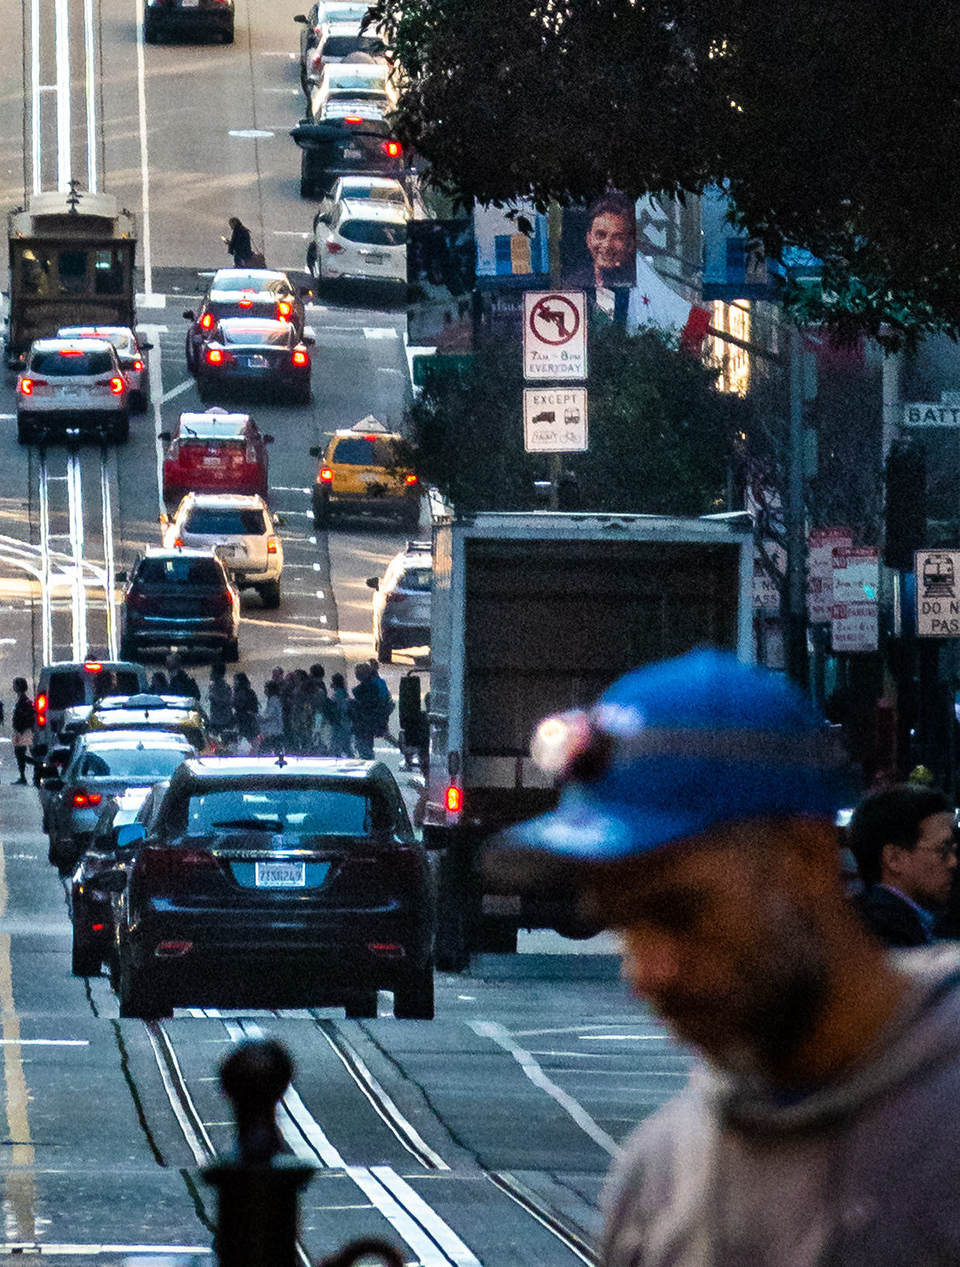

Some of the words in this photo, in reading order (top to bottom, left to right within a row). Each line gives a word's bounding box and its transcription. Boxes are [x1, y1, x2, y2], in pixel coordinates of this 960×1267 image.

[529, 363, 582, 373] EVERYDAY
[533, 393, 577, 405] EXCEPT
[922, 601, 941, 615] DO
